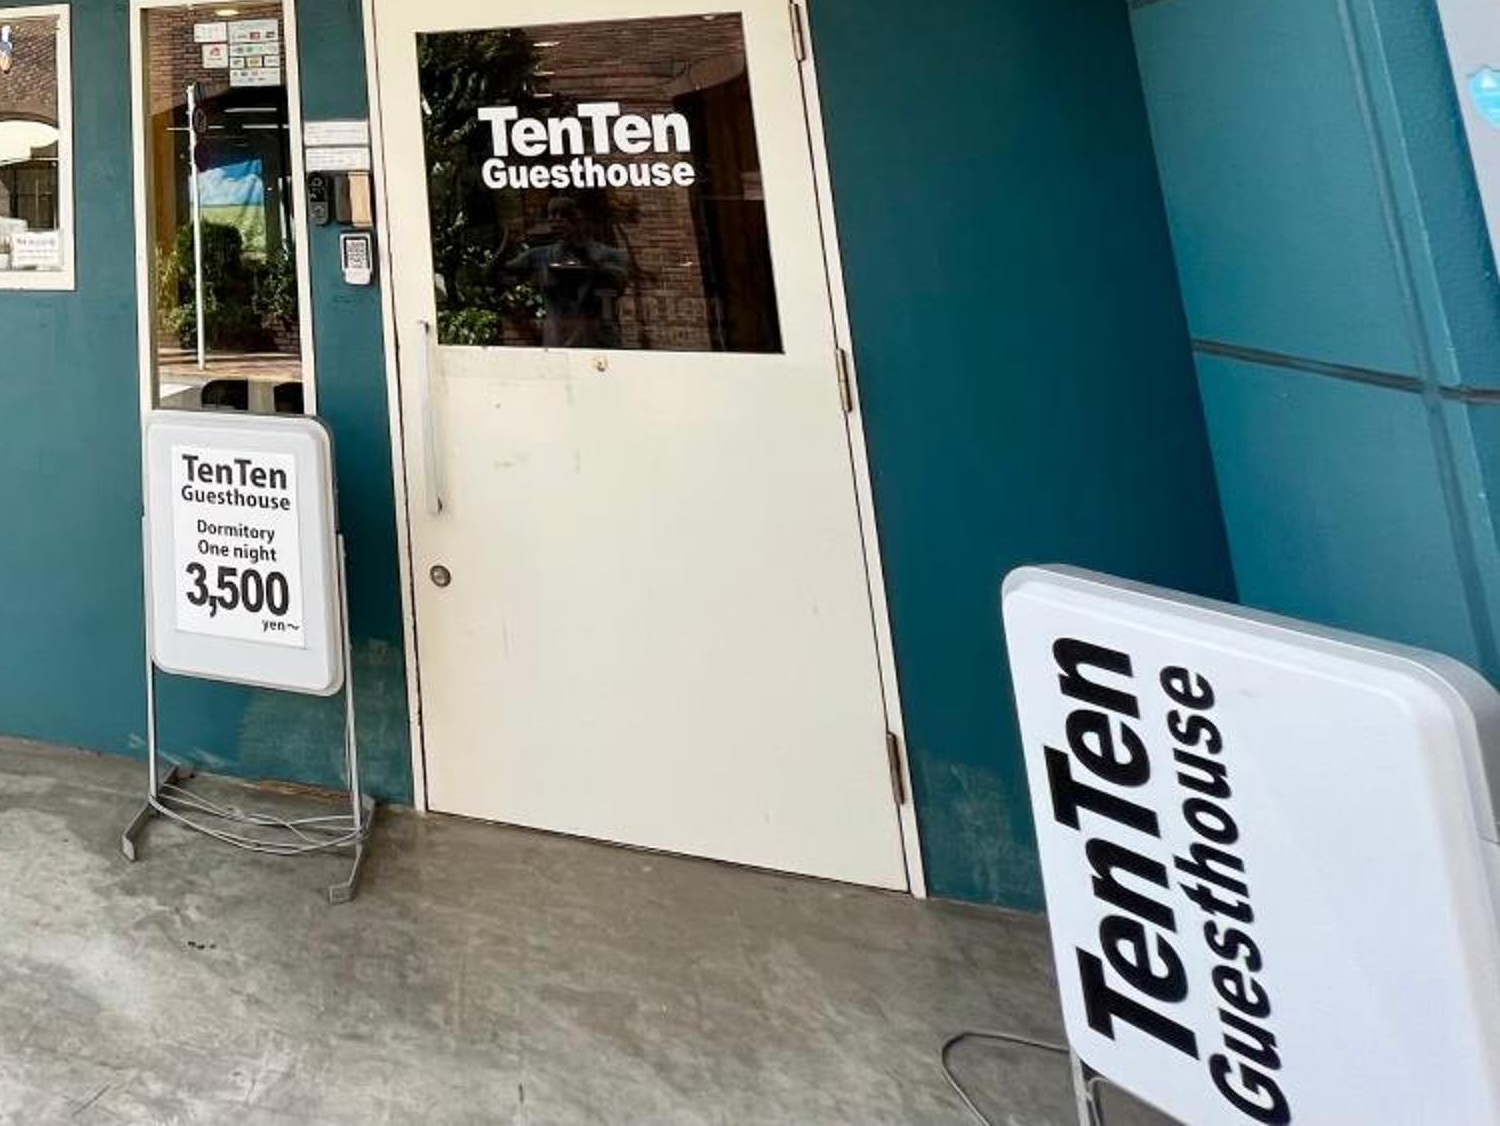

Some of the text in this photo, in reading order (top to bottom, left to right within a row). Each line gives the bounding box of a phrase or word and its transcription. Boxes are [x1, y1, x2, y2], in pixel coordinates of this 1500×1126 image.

[476, 102, 691, 156] TenTen
[481, 157, 695, 189] Guesthouse
[182, 453, 288, 490] TenTen
[181, 485, 291, 511] Guesthouse
[197, 519, 276, 543] Dormitory
[198, 540, 277, 564] One night
[185, 561, 290, 618] 3,500
[1043, 637, 1201, 1061] TenTen
[1159, 665, 1291, 1126] Guesthouse
